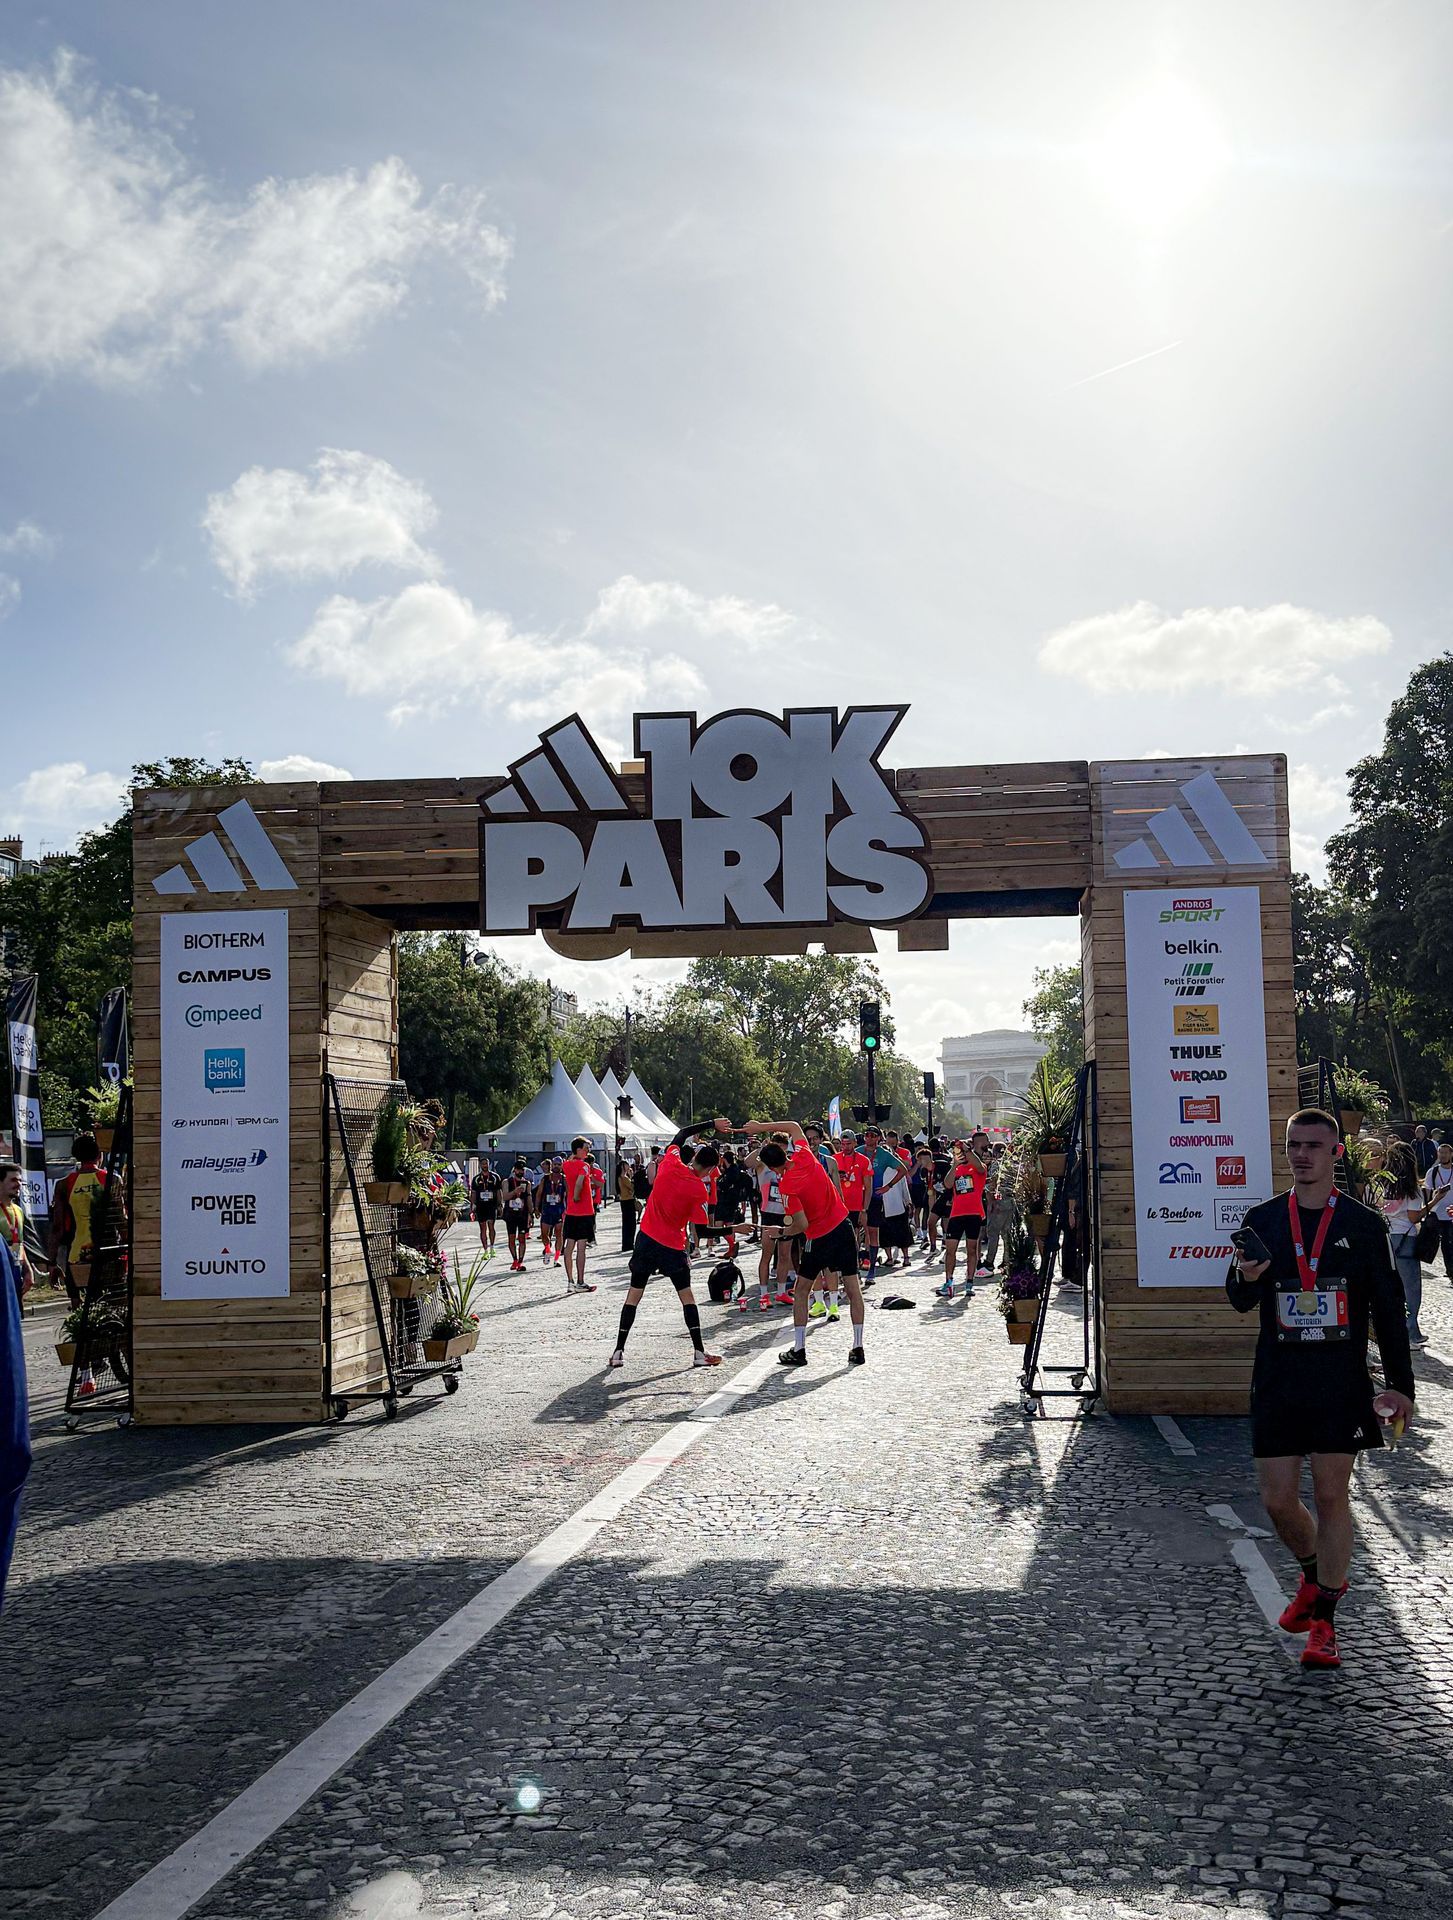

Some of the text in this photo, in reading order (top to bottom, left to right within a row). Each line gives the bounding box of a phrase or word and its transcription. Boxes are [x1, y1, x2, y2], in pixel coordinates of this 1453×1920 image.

[635, 704, 909, 819] 10K
[482, 811, 931, 936] PARIS
[1174, 899, 1211, 909] ANDROS
[1158, 908, 1226, 923] SPORT
[184, 932, 265, 949] BIOTHERM
[178, 968, 271, 983] CAMPUS
[1164, 976, 1225, 985] Petit Forestier
[185, 1004, 263, 1027] Compeed
[1170, 1045, 1222, 1059] THULE
[208, 1058, 239, 1069] Hello
[208, 1068, 242, 1080] bank!
[1170, 1069, 1227, 1083] WEROAD
[189, 1118, 229, 1126] HYUNDAI
[1169, 1135, 1233, 1147] COSMOPOLITAN
[181, 1156, 247, 1171] malaysia
[1219, 1164, 1243, 1176] RTL2
[191, 1194, 257, 1211] POWER
[1221, 1204, 1250, 1212] GROUP
[221, 1210, 257, 1225] ADE
[1147, 1206, 1203, 1219] le Bonbon
[1222, 1213, 1246, 1223] RAT
[185, 1259, 266, 1275] SUUNTO
[1286, 1294, 1328, 1316] 25
[1300, 1333, 1326, 1341] PARIS
